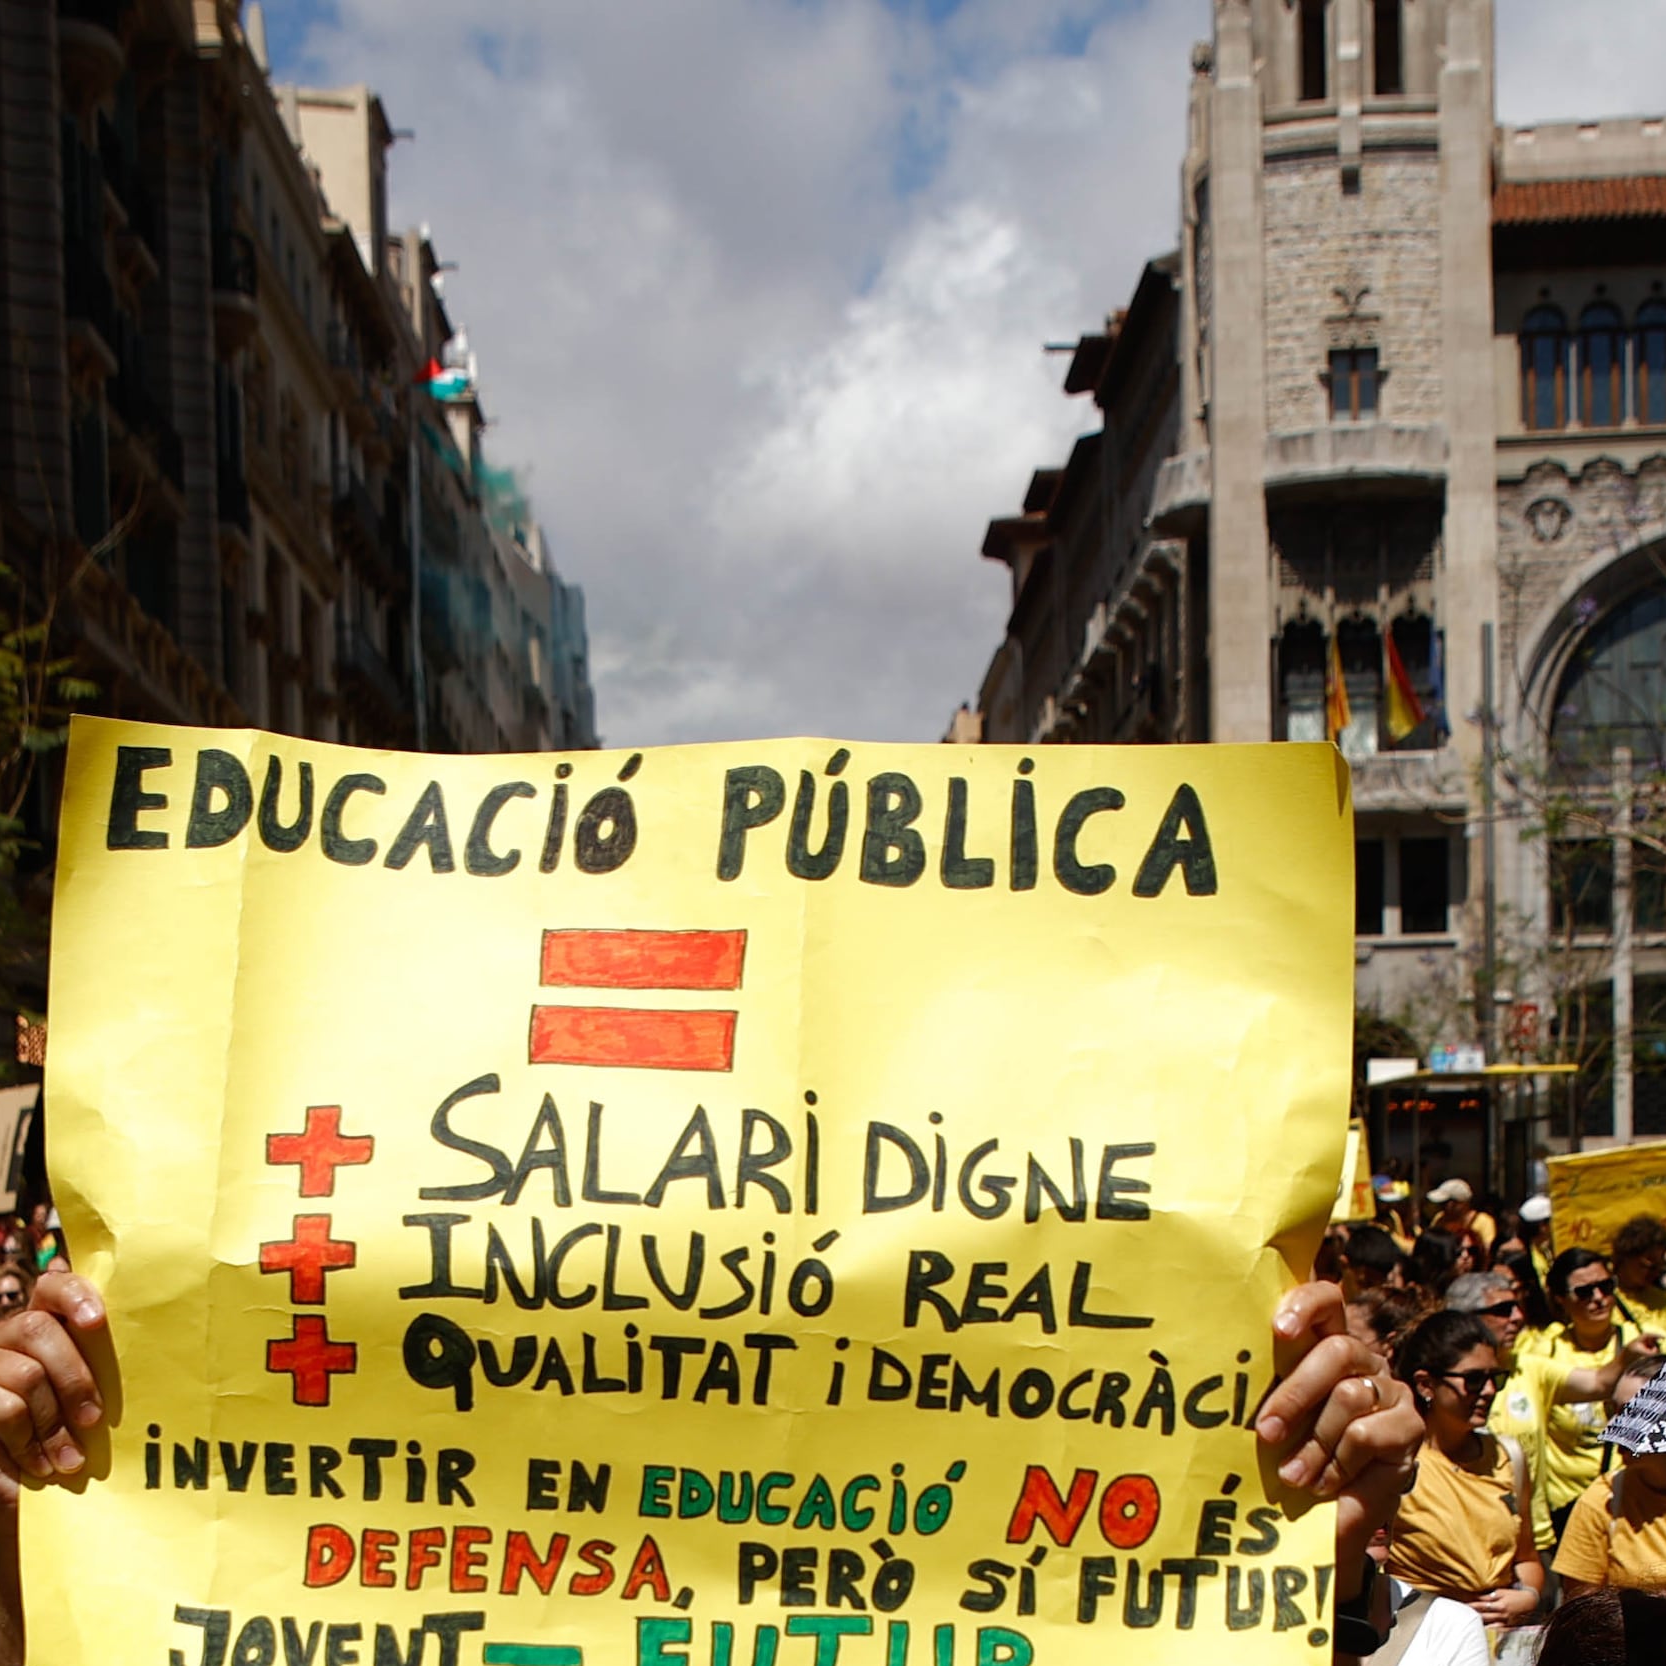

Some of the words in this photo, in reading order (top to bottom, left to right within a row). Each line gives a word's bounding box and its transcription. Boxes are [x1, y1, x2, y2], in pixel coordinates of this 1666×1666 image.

[904, 1250, 1155, 1334] REAL
[526, 1458, 611, 1514] EN
[1006, 1465, 1161, 1549] NO
[1195, 1473, 1284, 1557] ÉS
[302, 1523, 694, 1610] DEFENSA,
[738, 1538, 915, 1612] PERÒ
[960, 1546, 1048, 1616] SÍ
[1076, 1556, 1334, 1648] FUTUR!
